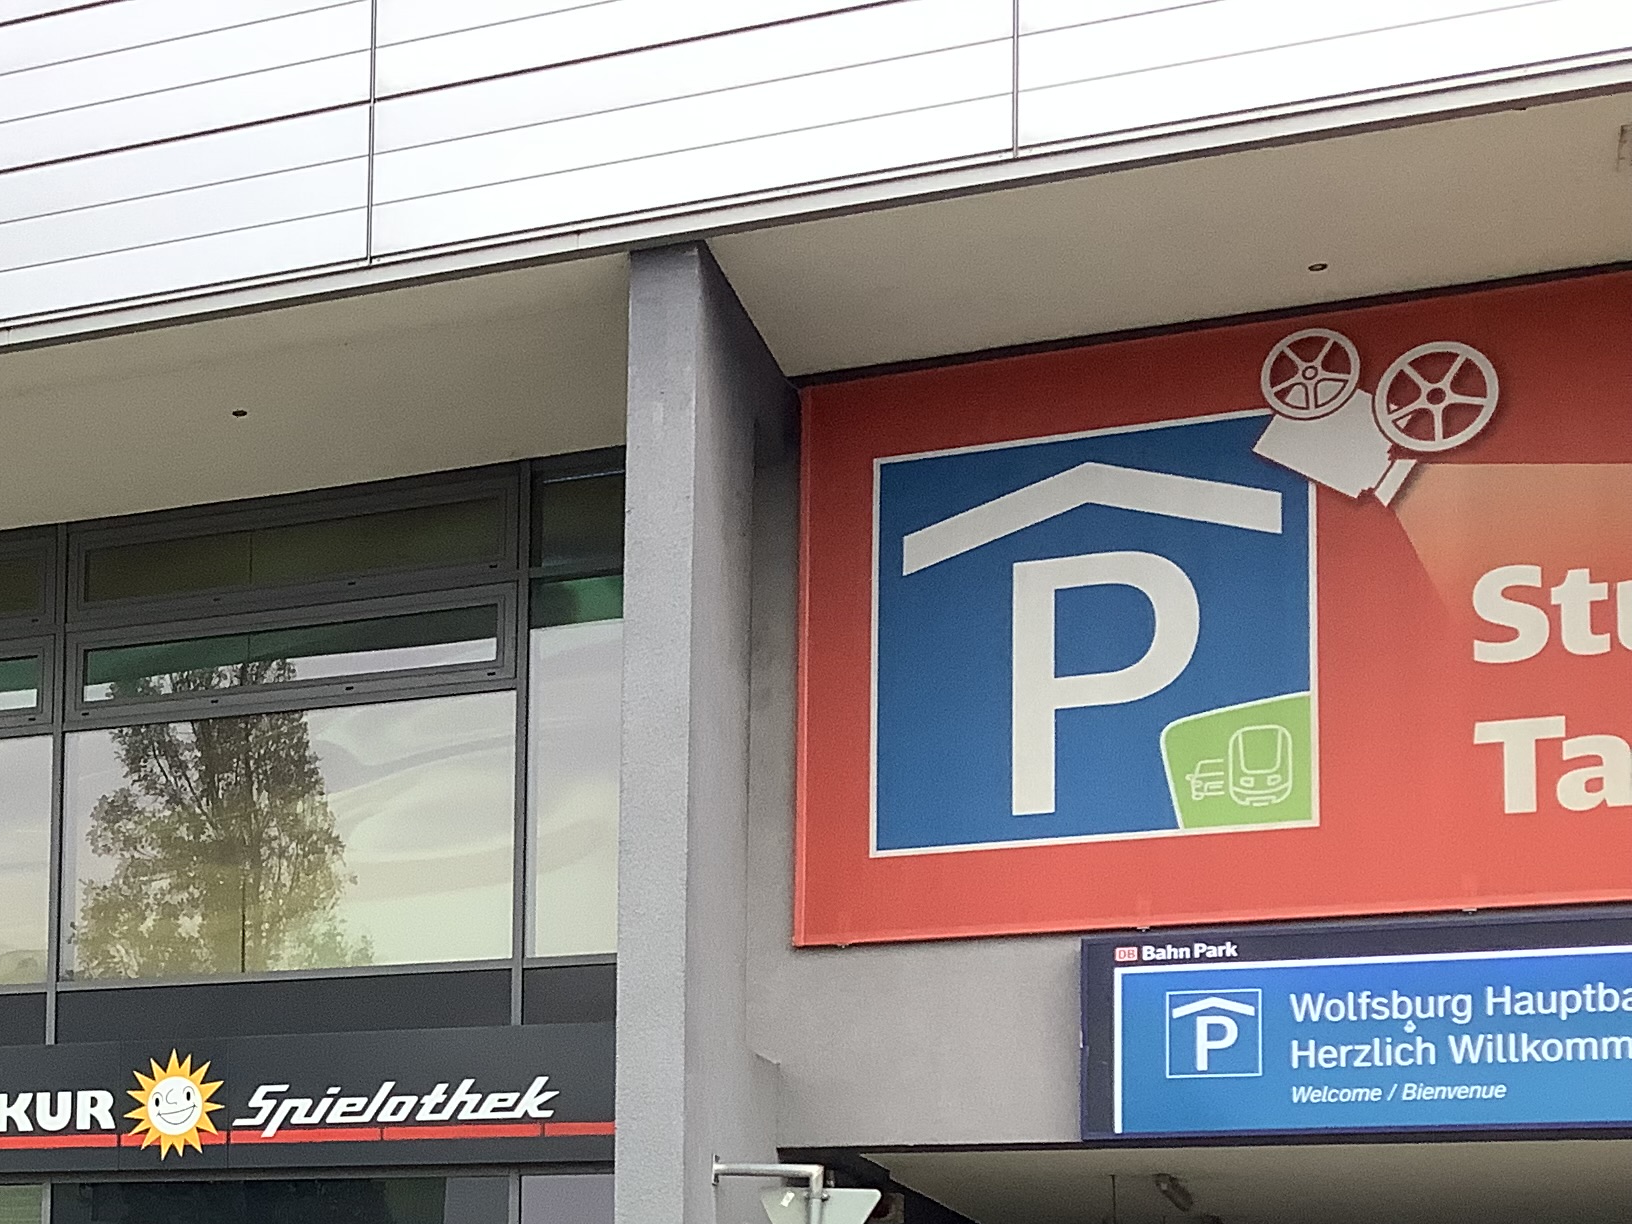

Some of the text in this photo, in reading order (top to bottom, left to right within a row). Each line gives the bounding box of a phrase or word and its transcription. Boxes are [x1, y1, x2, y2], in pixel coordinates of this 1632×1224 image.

[1472, 563, 1632, 663] St
[1011, 551, 1200, 816] P
[1141, 944, 1191, 961] Bahn
[1194, 941, 1238, 958] Park
[1289, 989, 1472, 1024] Wolfsburg
[1196, 1015, 1239, 1071] P
[1290, 1032, 1632, 1068] Herzlich Willkomm
[232, 1076, 560, 1137] Spielothek
[1292, 1082, 1508, 1103] Welcome / Bienvenue
